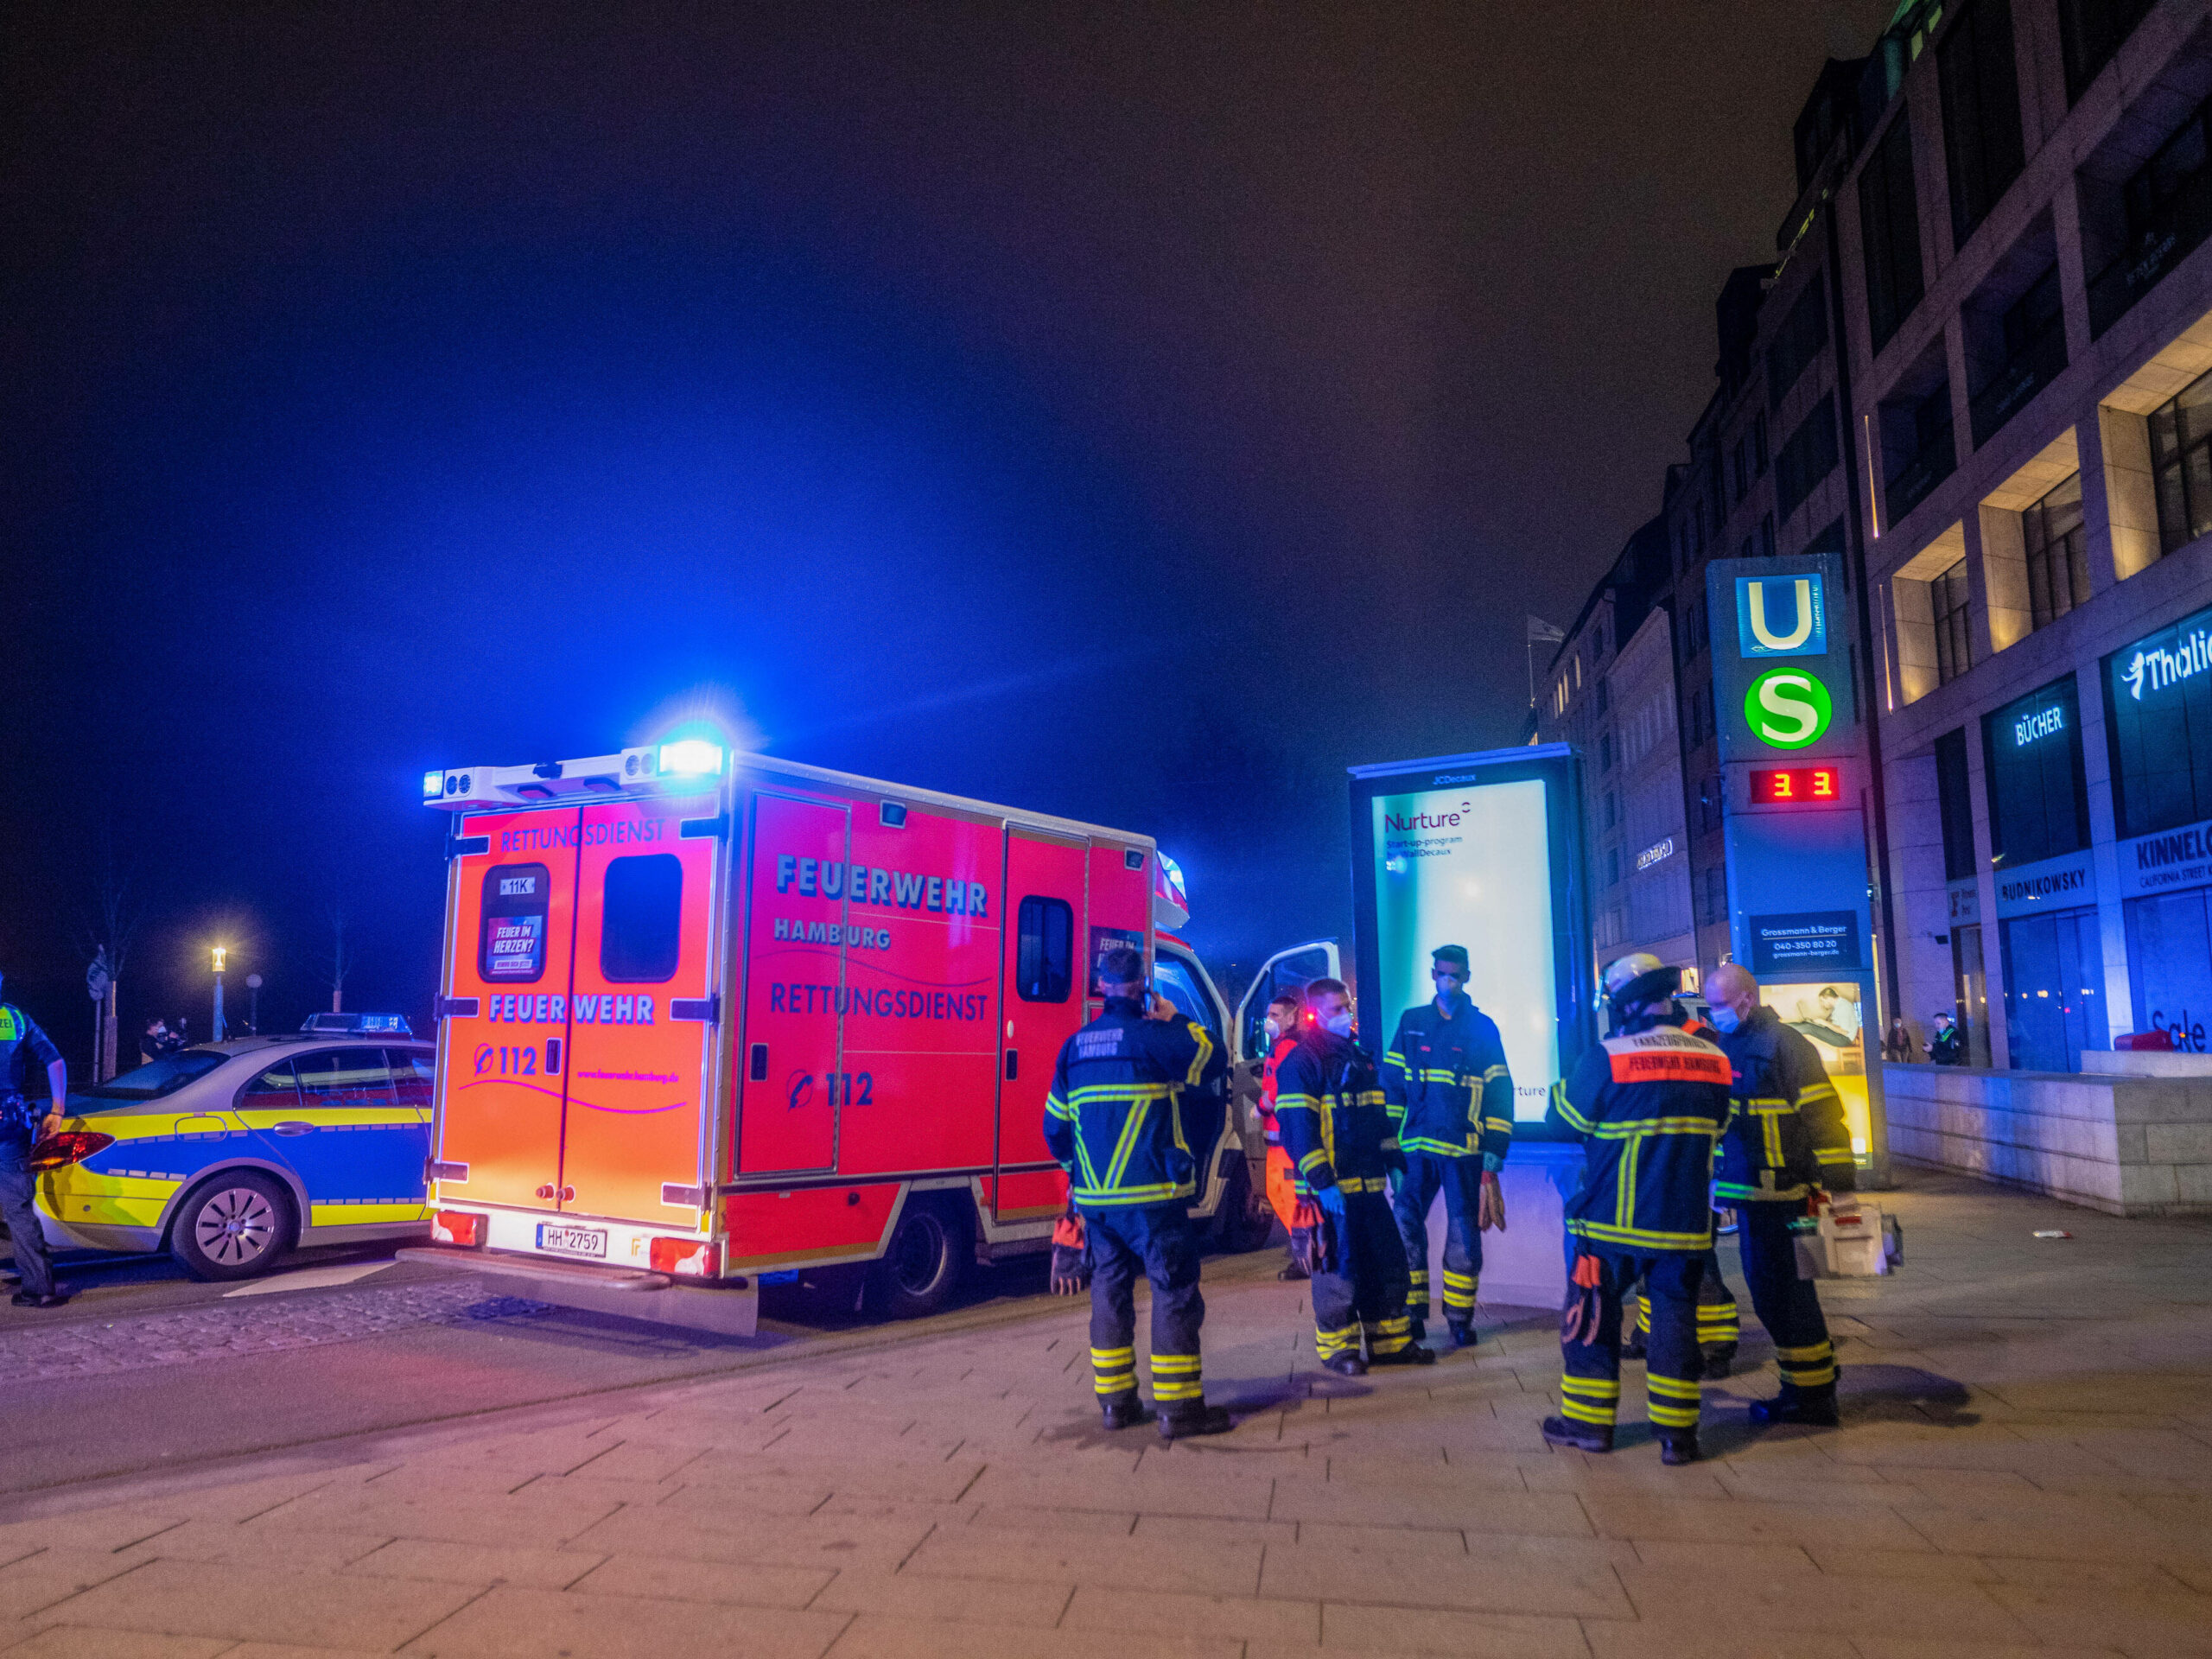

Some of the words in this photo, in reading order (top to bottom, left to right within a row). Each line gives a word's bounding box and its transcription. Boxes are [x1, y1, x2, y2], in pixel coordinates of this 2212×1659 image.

[1748, 579, 1812, 650] U
[1759, 675, 1818, 742] S
[2015, 707, 2063, 747] BÜCHER
[501, 819, 664, 852] RETTUNGSDIENST
[1385, 812, 1460, 833] Nurture
[509, 879, 528, 893] 11K
[777, 854, 988, 918] FEUERWEHR
[2002, 868, 2086, 901] BUDNIKOWSKY
[493, 938, 535, 954] HERZEN?
[497, 926, 521, 938] FEUER
[521, 925, 532, 938] IM
[774, 918, 892, 951] HAMBURG
[1762, 927, 1810, 937] Grossmann
[1818, 925, 1847, 934] Berger
[1774, 942, 1811, 950] 040-350
[489, 995, 654, 1025] FEUERWEHR
[771, 982, 988, 1021] RETTUNGSDIENST
[500, 1046, 537, 1075] 112
[825, 1071, 874, 1106] 112
[548, 1230, 563, 1247] HH
[569, 1232, 599, 1250] 2759
